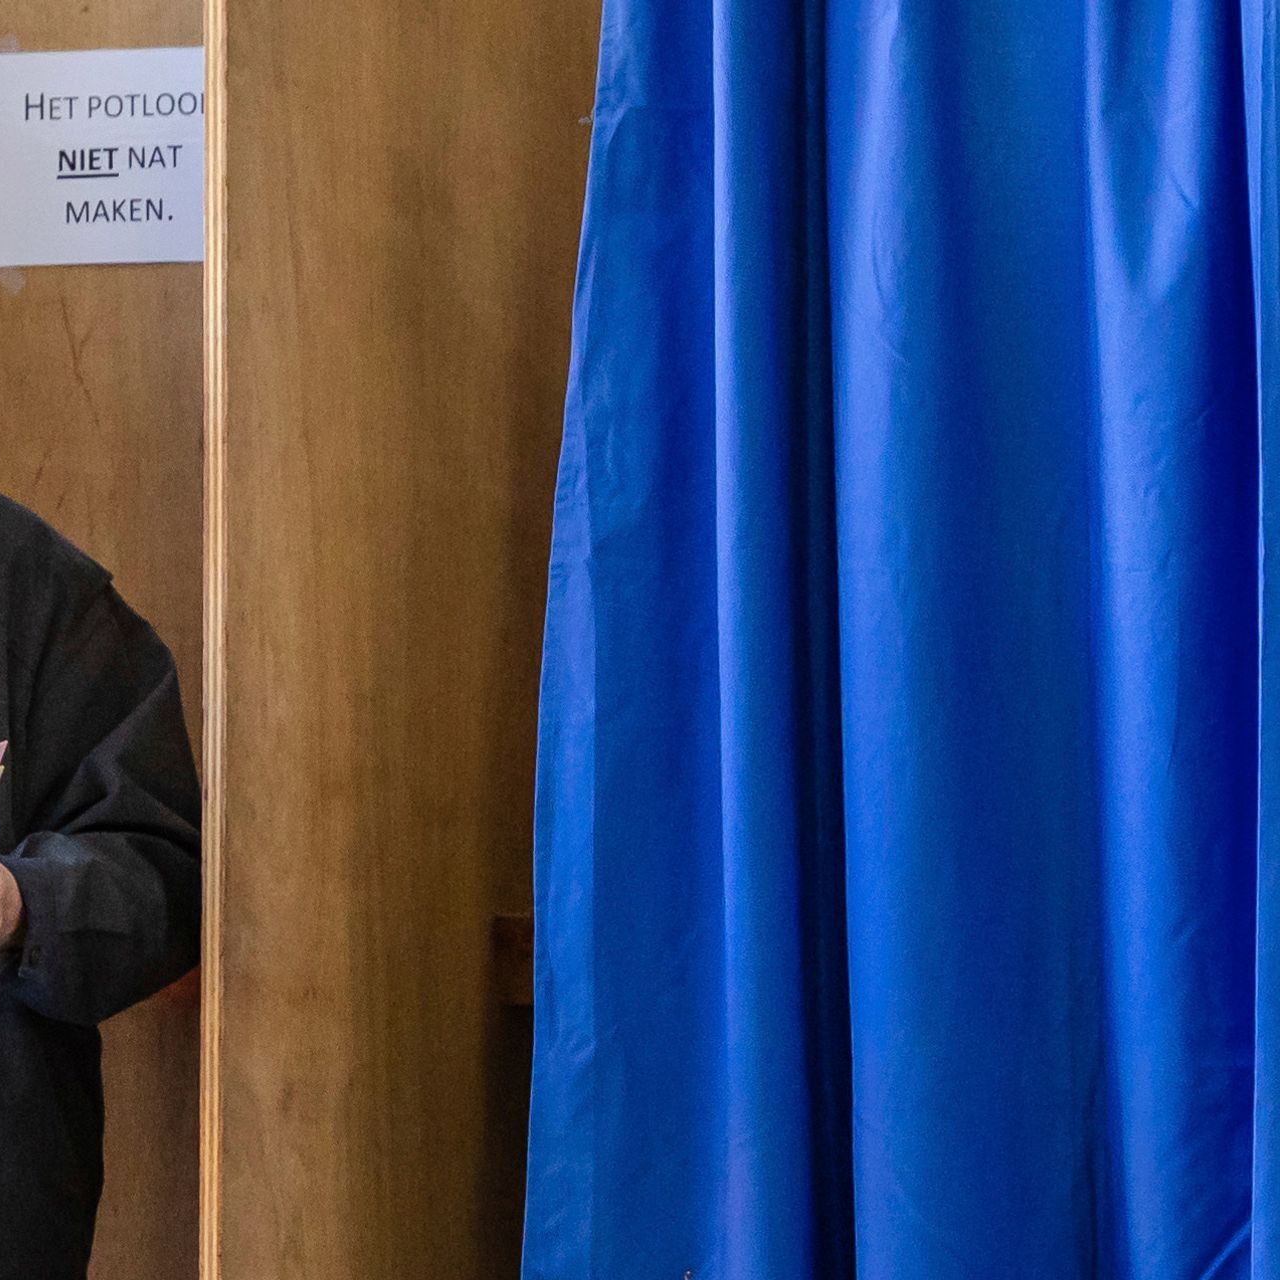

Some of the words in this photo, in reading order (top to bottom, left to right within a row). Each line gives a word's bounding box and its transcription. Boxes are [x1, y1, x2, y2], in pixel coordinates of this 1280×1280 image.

[24, 92, 79, 121] HET
[87, 91, 205, 119] POTLOO
[57, 147, 119, 172] NIET
[128, 144, 183, 169] NAT
[66, 198, 174, 224] MAKEN.
